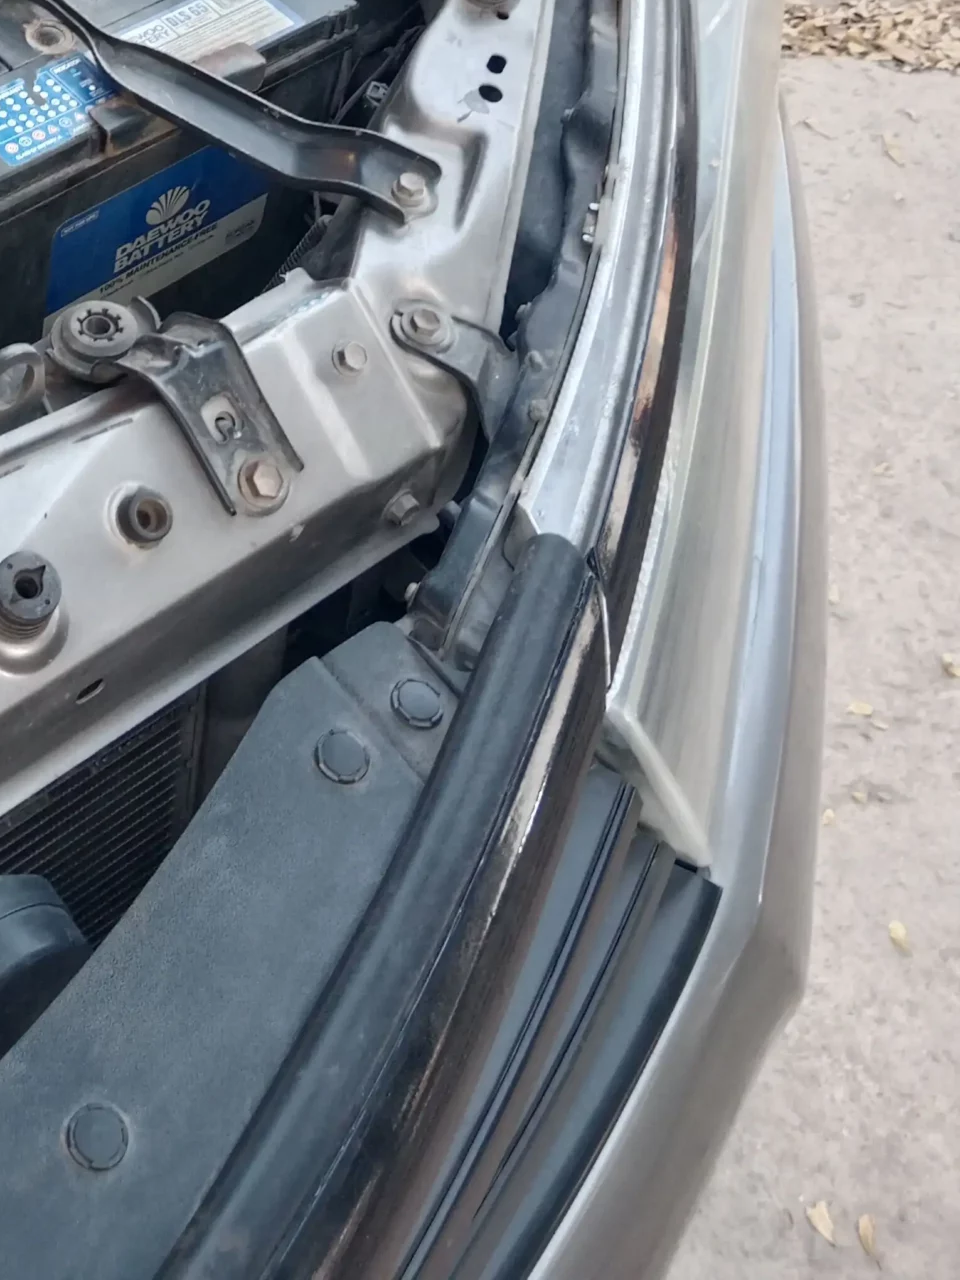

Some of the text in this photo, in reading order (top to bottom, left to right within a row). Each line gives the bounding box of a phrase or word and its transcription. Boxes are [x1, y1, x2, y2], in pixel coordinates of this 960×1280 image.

[166, 2, 209, 27] DLS 65
[113, 210, 209, 273] BATTERY
[115, 199, 211, 261] DAEWOO
